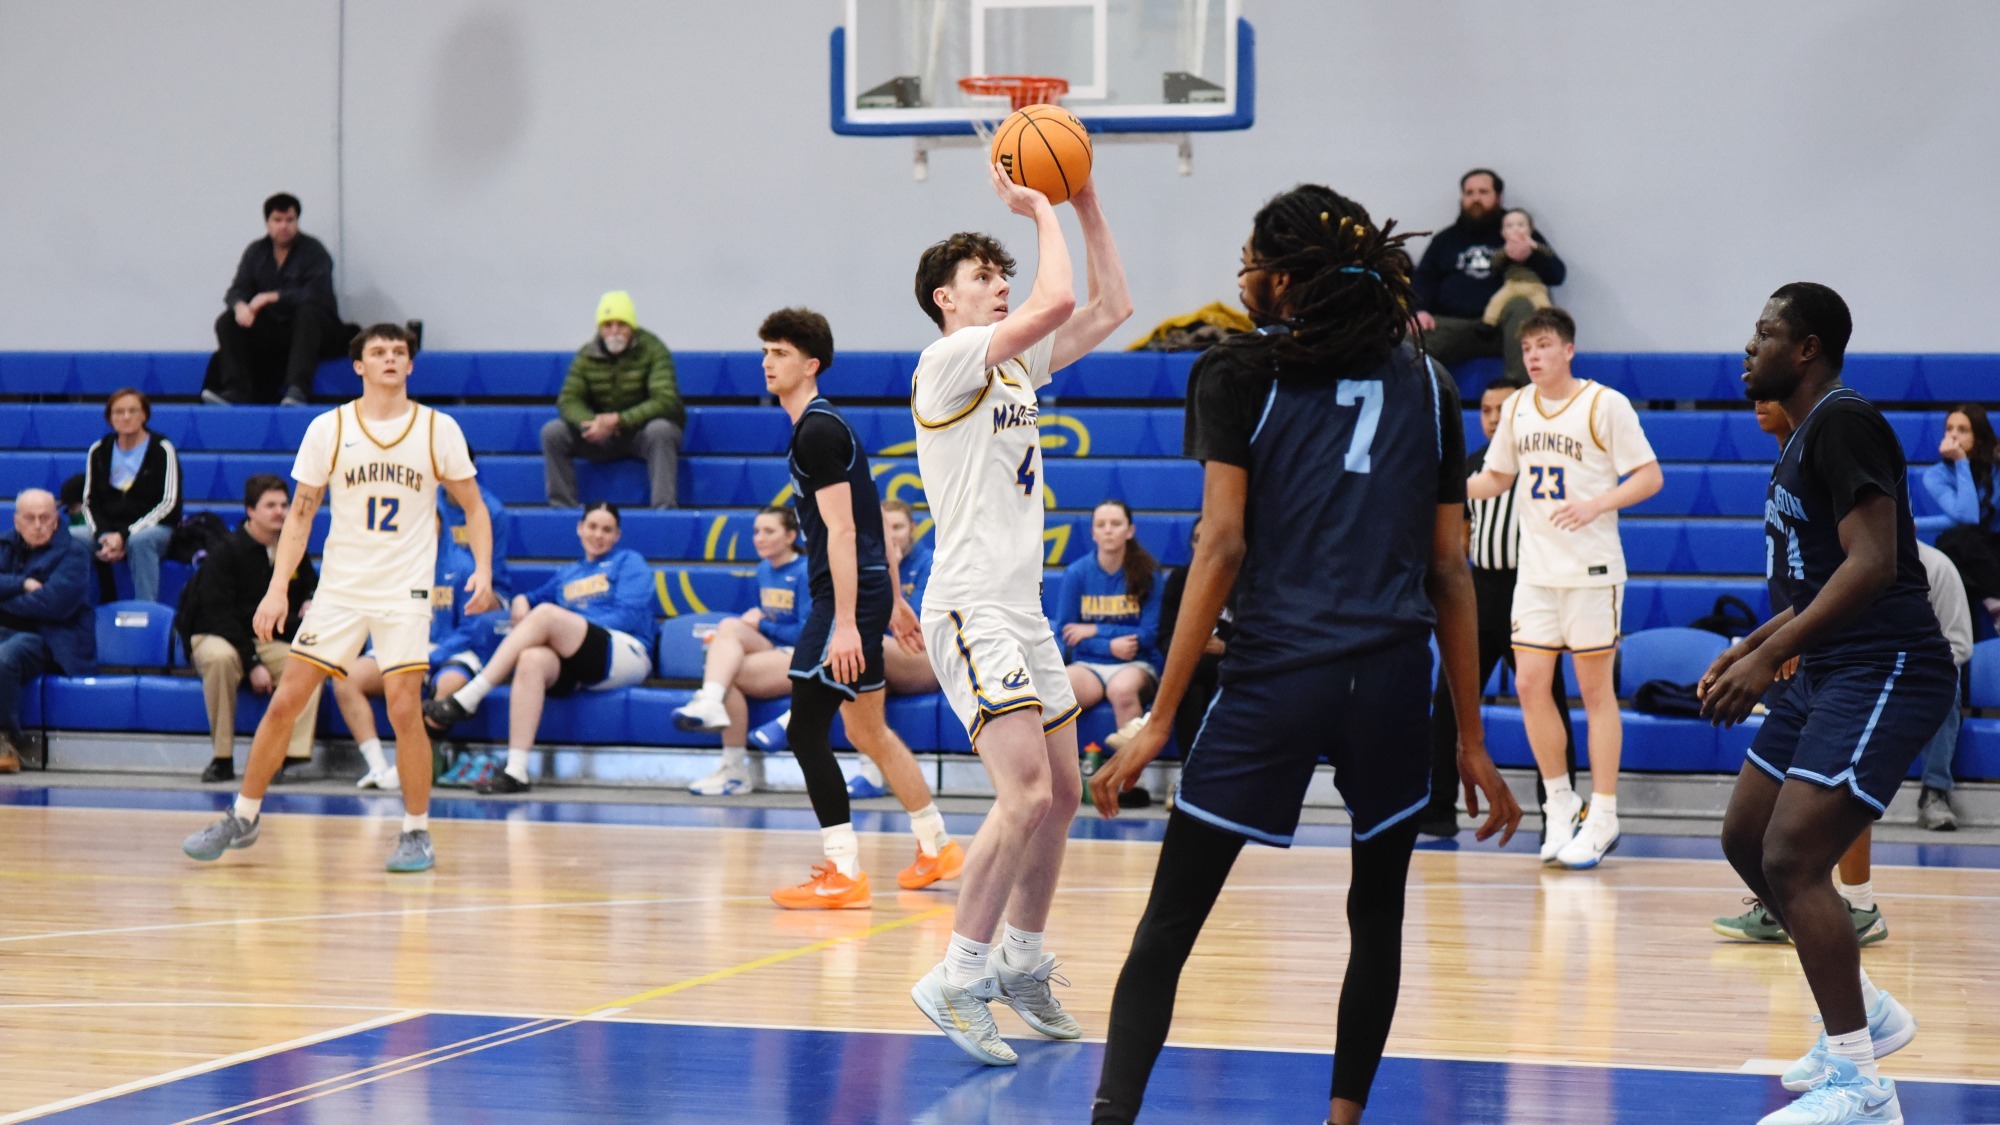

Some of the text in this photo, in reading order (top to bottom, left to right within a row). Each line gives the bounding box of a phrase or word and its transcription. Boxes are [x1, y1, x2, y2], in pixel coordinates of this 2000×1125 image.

[1336, 379, 1384, 473] 7
[345, 462, 423, 493] MARINERS
[1015, 444, 1035, 496] 4
[1529, 464, 1566, 500] 23
[366, 494, 399, 532] 12
